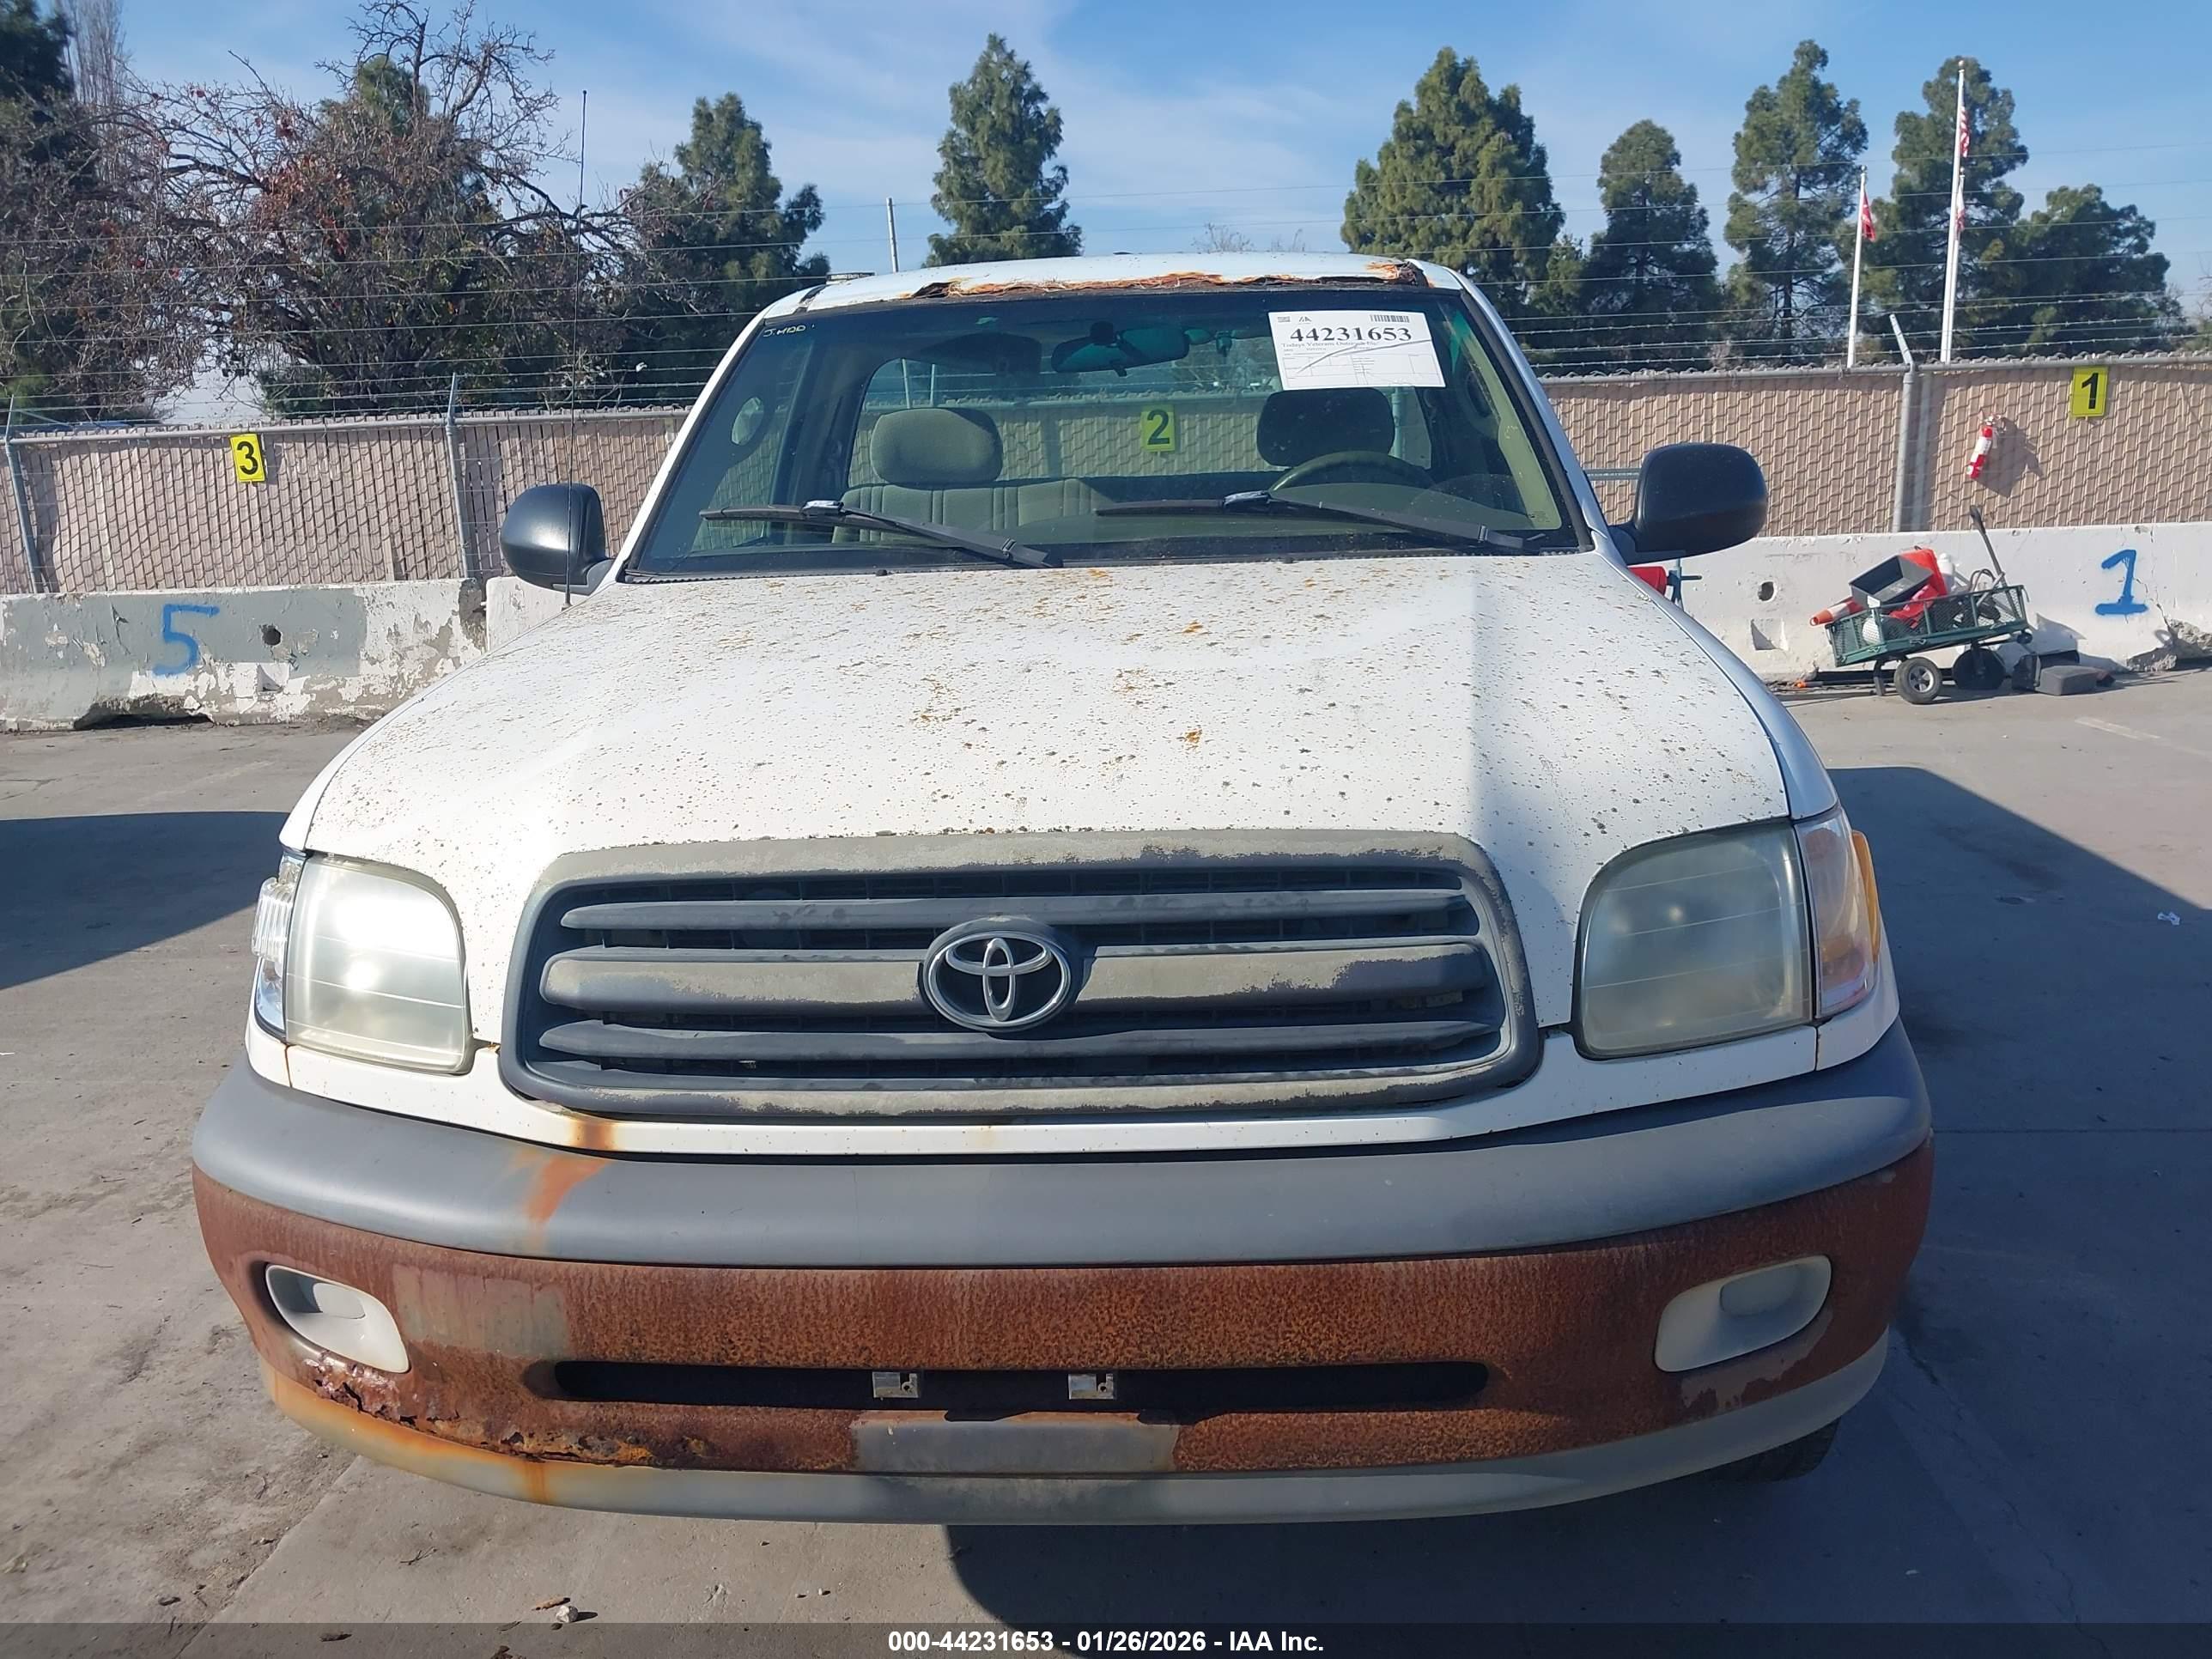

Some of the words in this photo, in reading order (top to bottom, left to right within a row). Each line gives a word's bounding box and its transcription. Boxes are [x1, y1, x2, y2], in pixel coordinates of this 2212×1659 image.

[1290, 326, 1413, 342] 44231653
[2081, 372, 2100, 410] 1
[1146, 409, 1170, 446] 2
[236, 441, 258, 475] 3
[2095, 549, 2148, 616] 1
[152, 604, 221, 676] 5
